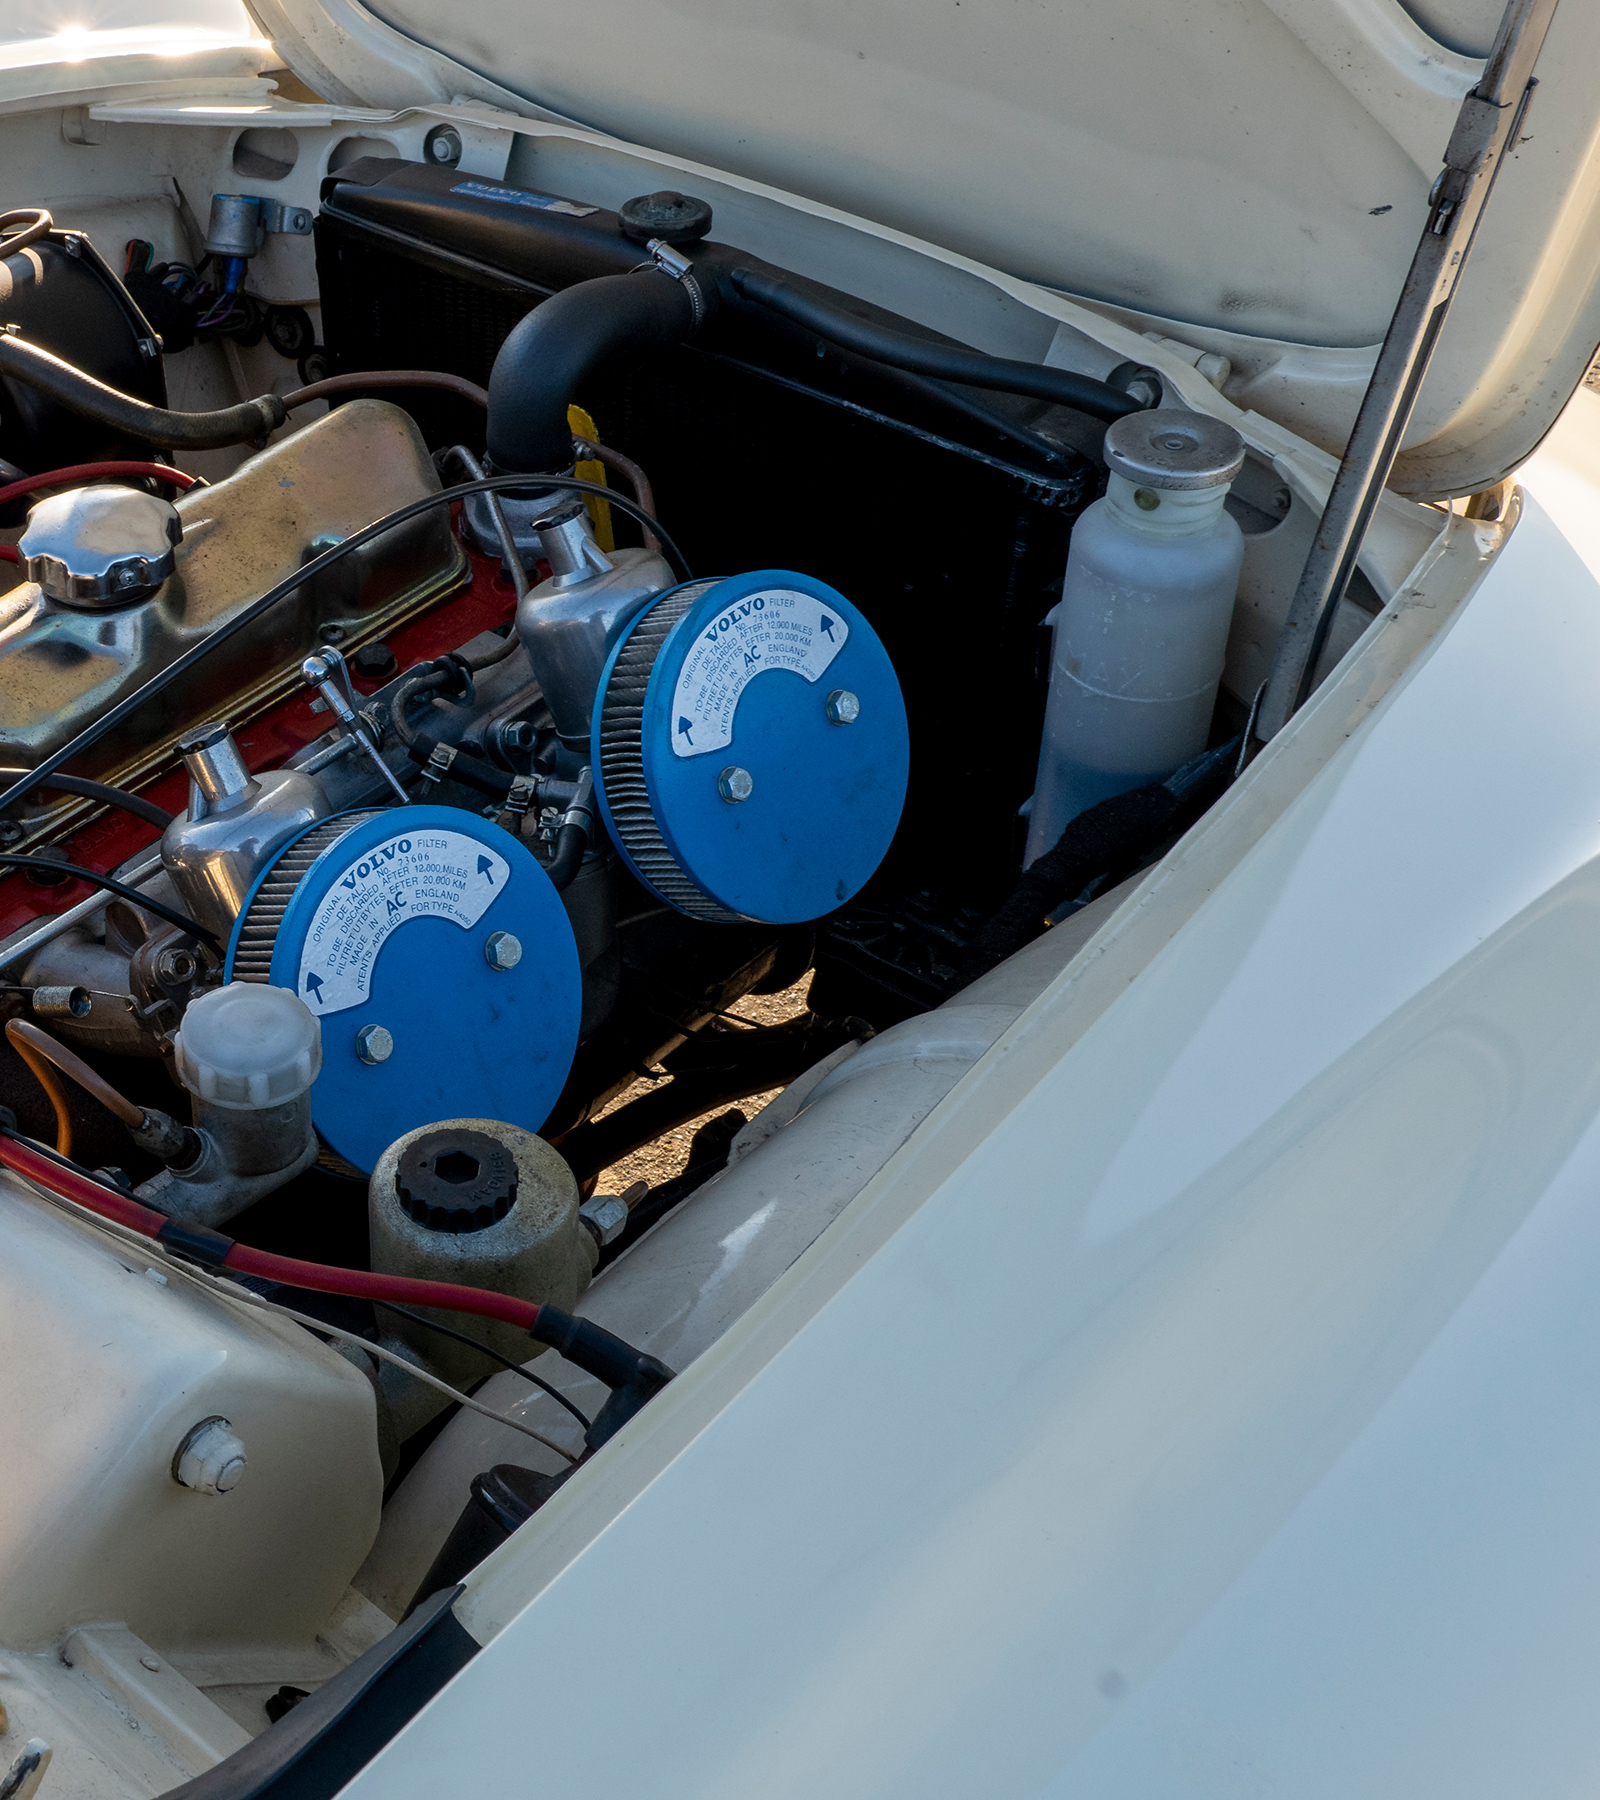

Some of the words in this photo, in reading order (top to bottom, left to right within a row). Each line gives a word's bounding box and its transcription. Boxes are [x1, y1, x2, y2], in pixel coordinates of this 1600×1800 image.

[682, 646, 706, 689] ORIGINAL
[704, 597, 765, 643] VOLVO
[769, 597, 795, 608] FILTER
[694, 699, 703, 713] TO
[699, 685, 709, 699] BE
[705, 637, 738, 683] DISCARDED
[740, 622, 763, 640] AFTER
[791, 622, 813, 637] MILES
[703, 681, 720, 721] FILTRET
[716, 645, 744, 682] UTBYTES
[745, 632, 771, 648] EFTER
[800, 636, 812, 647] KM
[713, 683, 729, 712] MADE
[728, 668, 738, 680] IN
[744, 645, 762, 668] AC
[768, 644, 807, 658] ENGLAND
[721, 697, 733, 736] ATENTS
[731, 665, 757, 696] APPLIED
[764, 655, 781, 667] FOR
[781, 655, 802, 668] TYPE
[313, 895, 342, 943] ORIGINAL
[339, 839, 412, 890] VOLVO
[417, 839, 448, 850] FILTER
[398, 852, 430, 866] 73606
[326, 953, 337, 968] TO
[332, 937, 343, 952] BE
[340, 884, 379, 934] DISCARDED
[382, 866, 410, 887] AFTER
[442, 865, 468, 879] MILES
[336, 933, 356, 976] FILTRET
[353, 892, 387, 933] UTBYTES
[389, 876, 418, 895] EFTER
[452, 879, 466, 890] KM
[349, 934, 368, 966] MADE
[368, 917, 379, 931] IN
[386, 891, 407, 916] AC
[415, 888, 460, 903] ENGLAND
[357, 950, 373, 992] ATENTS
[372, 912, 402, 948] APPLIED
[411, 902, 430, 913] FOR
[432, 902, 454, 914] TYPE
